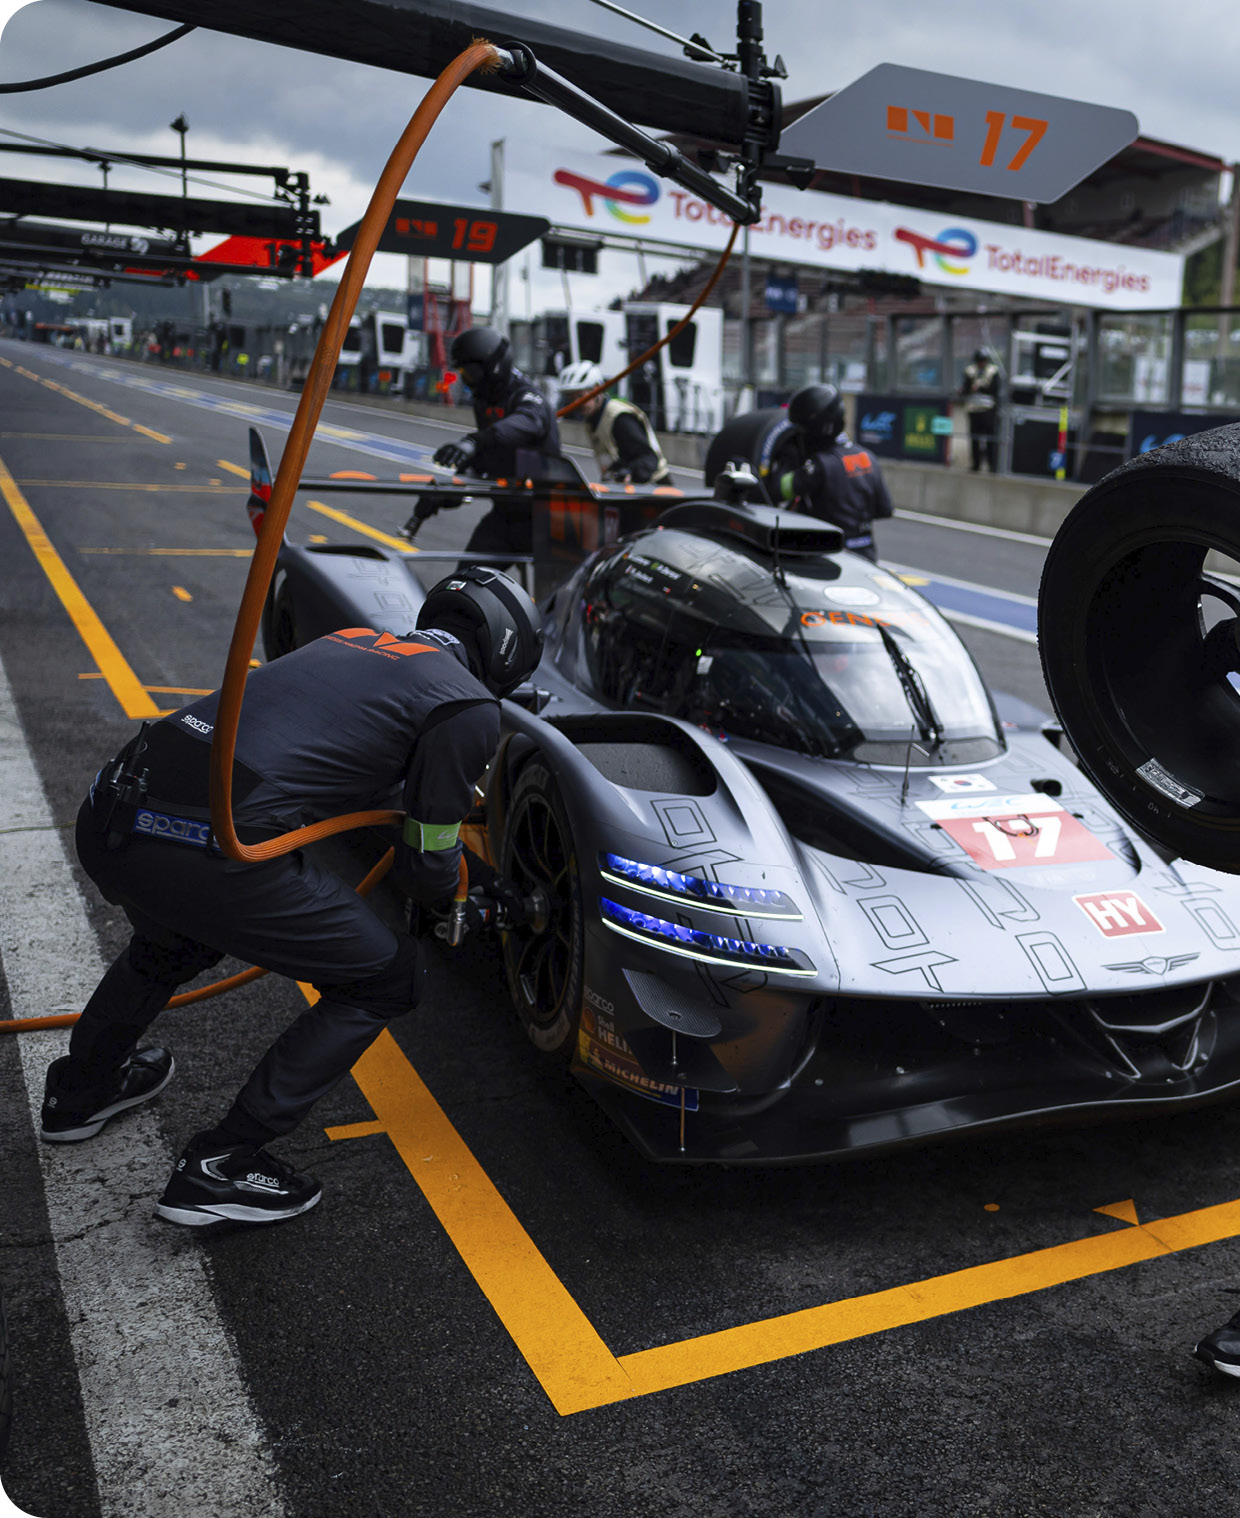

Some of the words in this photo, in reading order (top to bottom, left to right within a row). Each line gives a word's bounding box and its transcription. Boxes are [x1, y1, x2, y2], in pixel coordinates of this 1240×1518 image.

[979, 110, 1049, 171] 17
[452, 218, 498, 253] 19
[669, 189, 877, 252] Totnergies
[81, 233, 128, 250] GARAGE
[985, 245, 1151, 293] TotalEnergies
[182, 714, 214, 735] sparco
[136, 812, 210, 838] sparc
[972, 816, 1062, 862] 17
[1083, 897, 1147, 931] HY
[598, 1026, 633, 1055] HELI
[605, 1058, 680, 1096] MICHELIN
